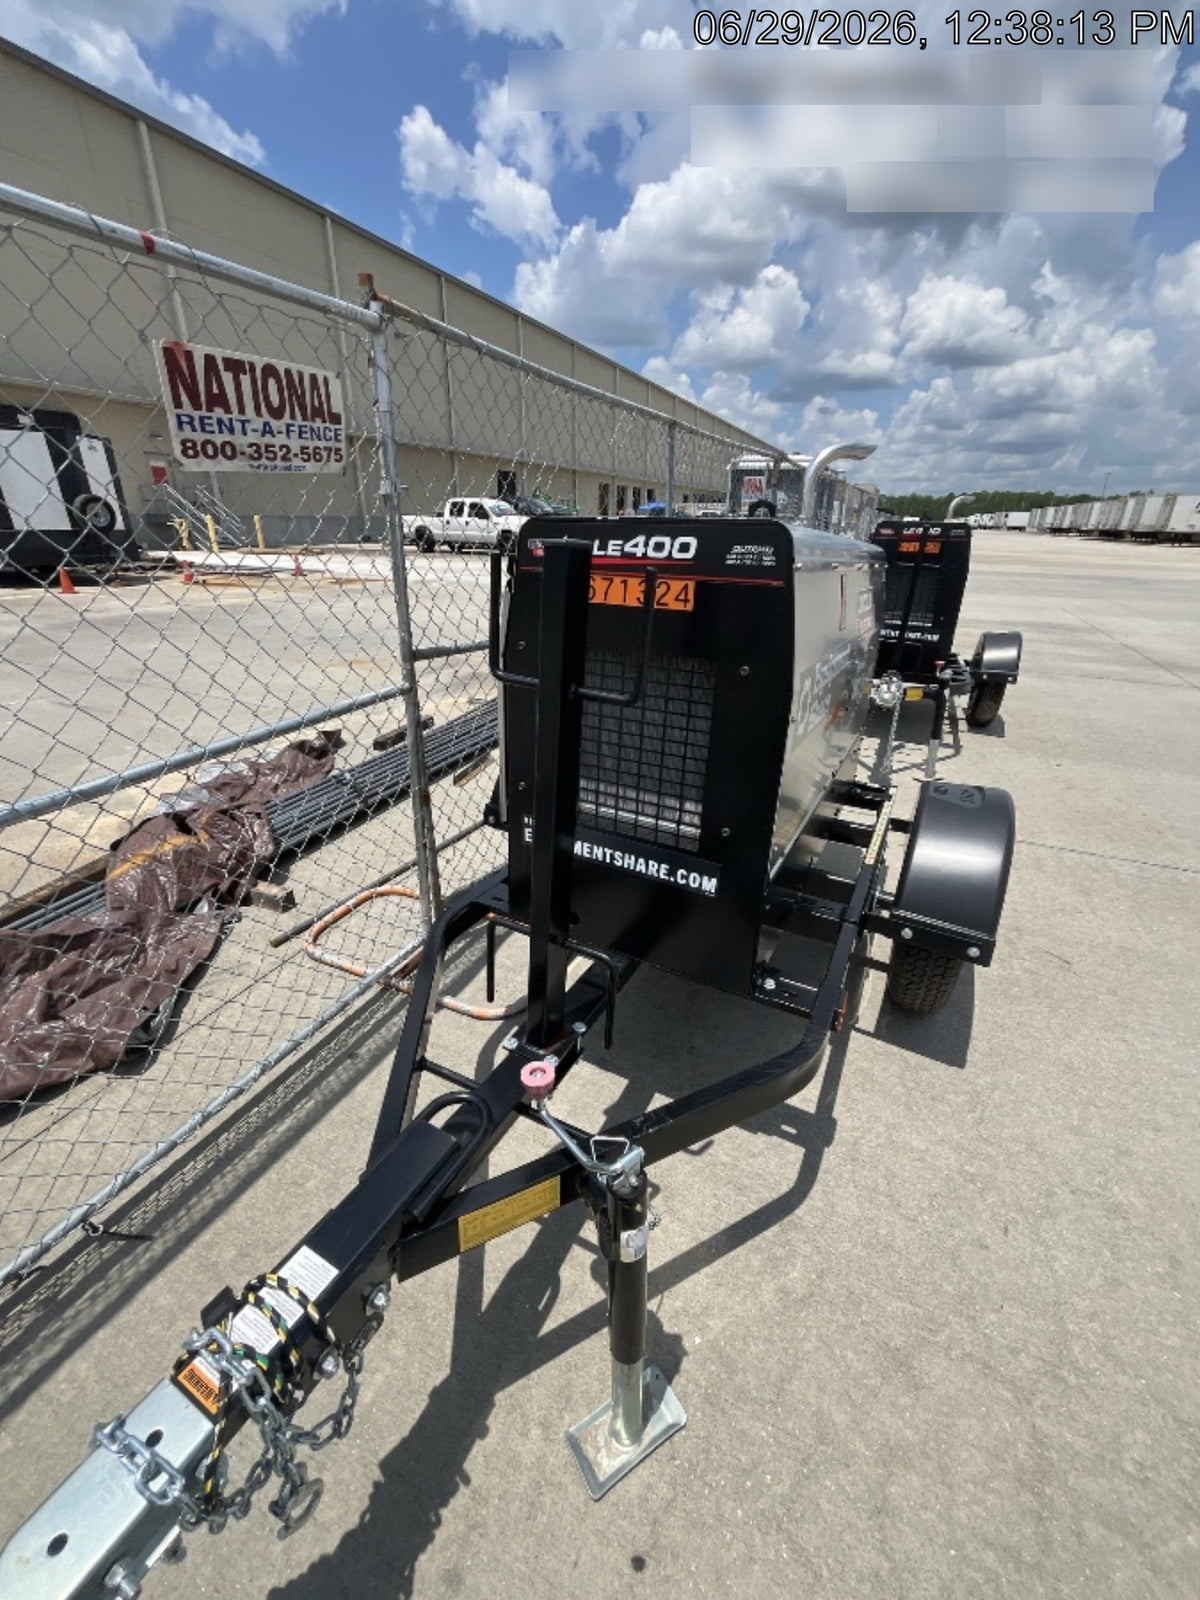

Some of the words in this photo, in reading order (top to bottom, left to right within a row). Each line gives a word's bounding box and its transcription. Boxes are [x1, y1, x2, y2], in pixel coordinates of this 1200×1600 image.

[162, 346, 342, 425] NATIONAL
[176, 413, 342, 443] RENT-A-FENCE
[180, 438, 343, 463] 800-352-5675
